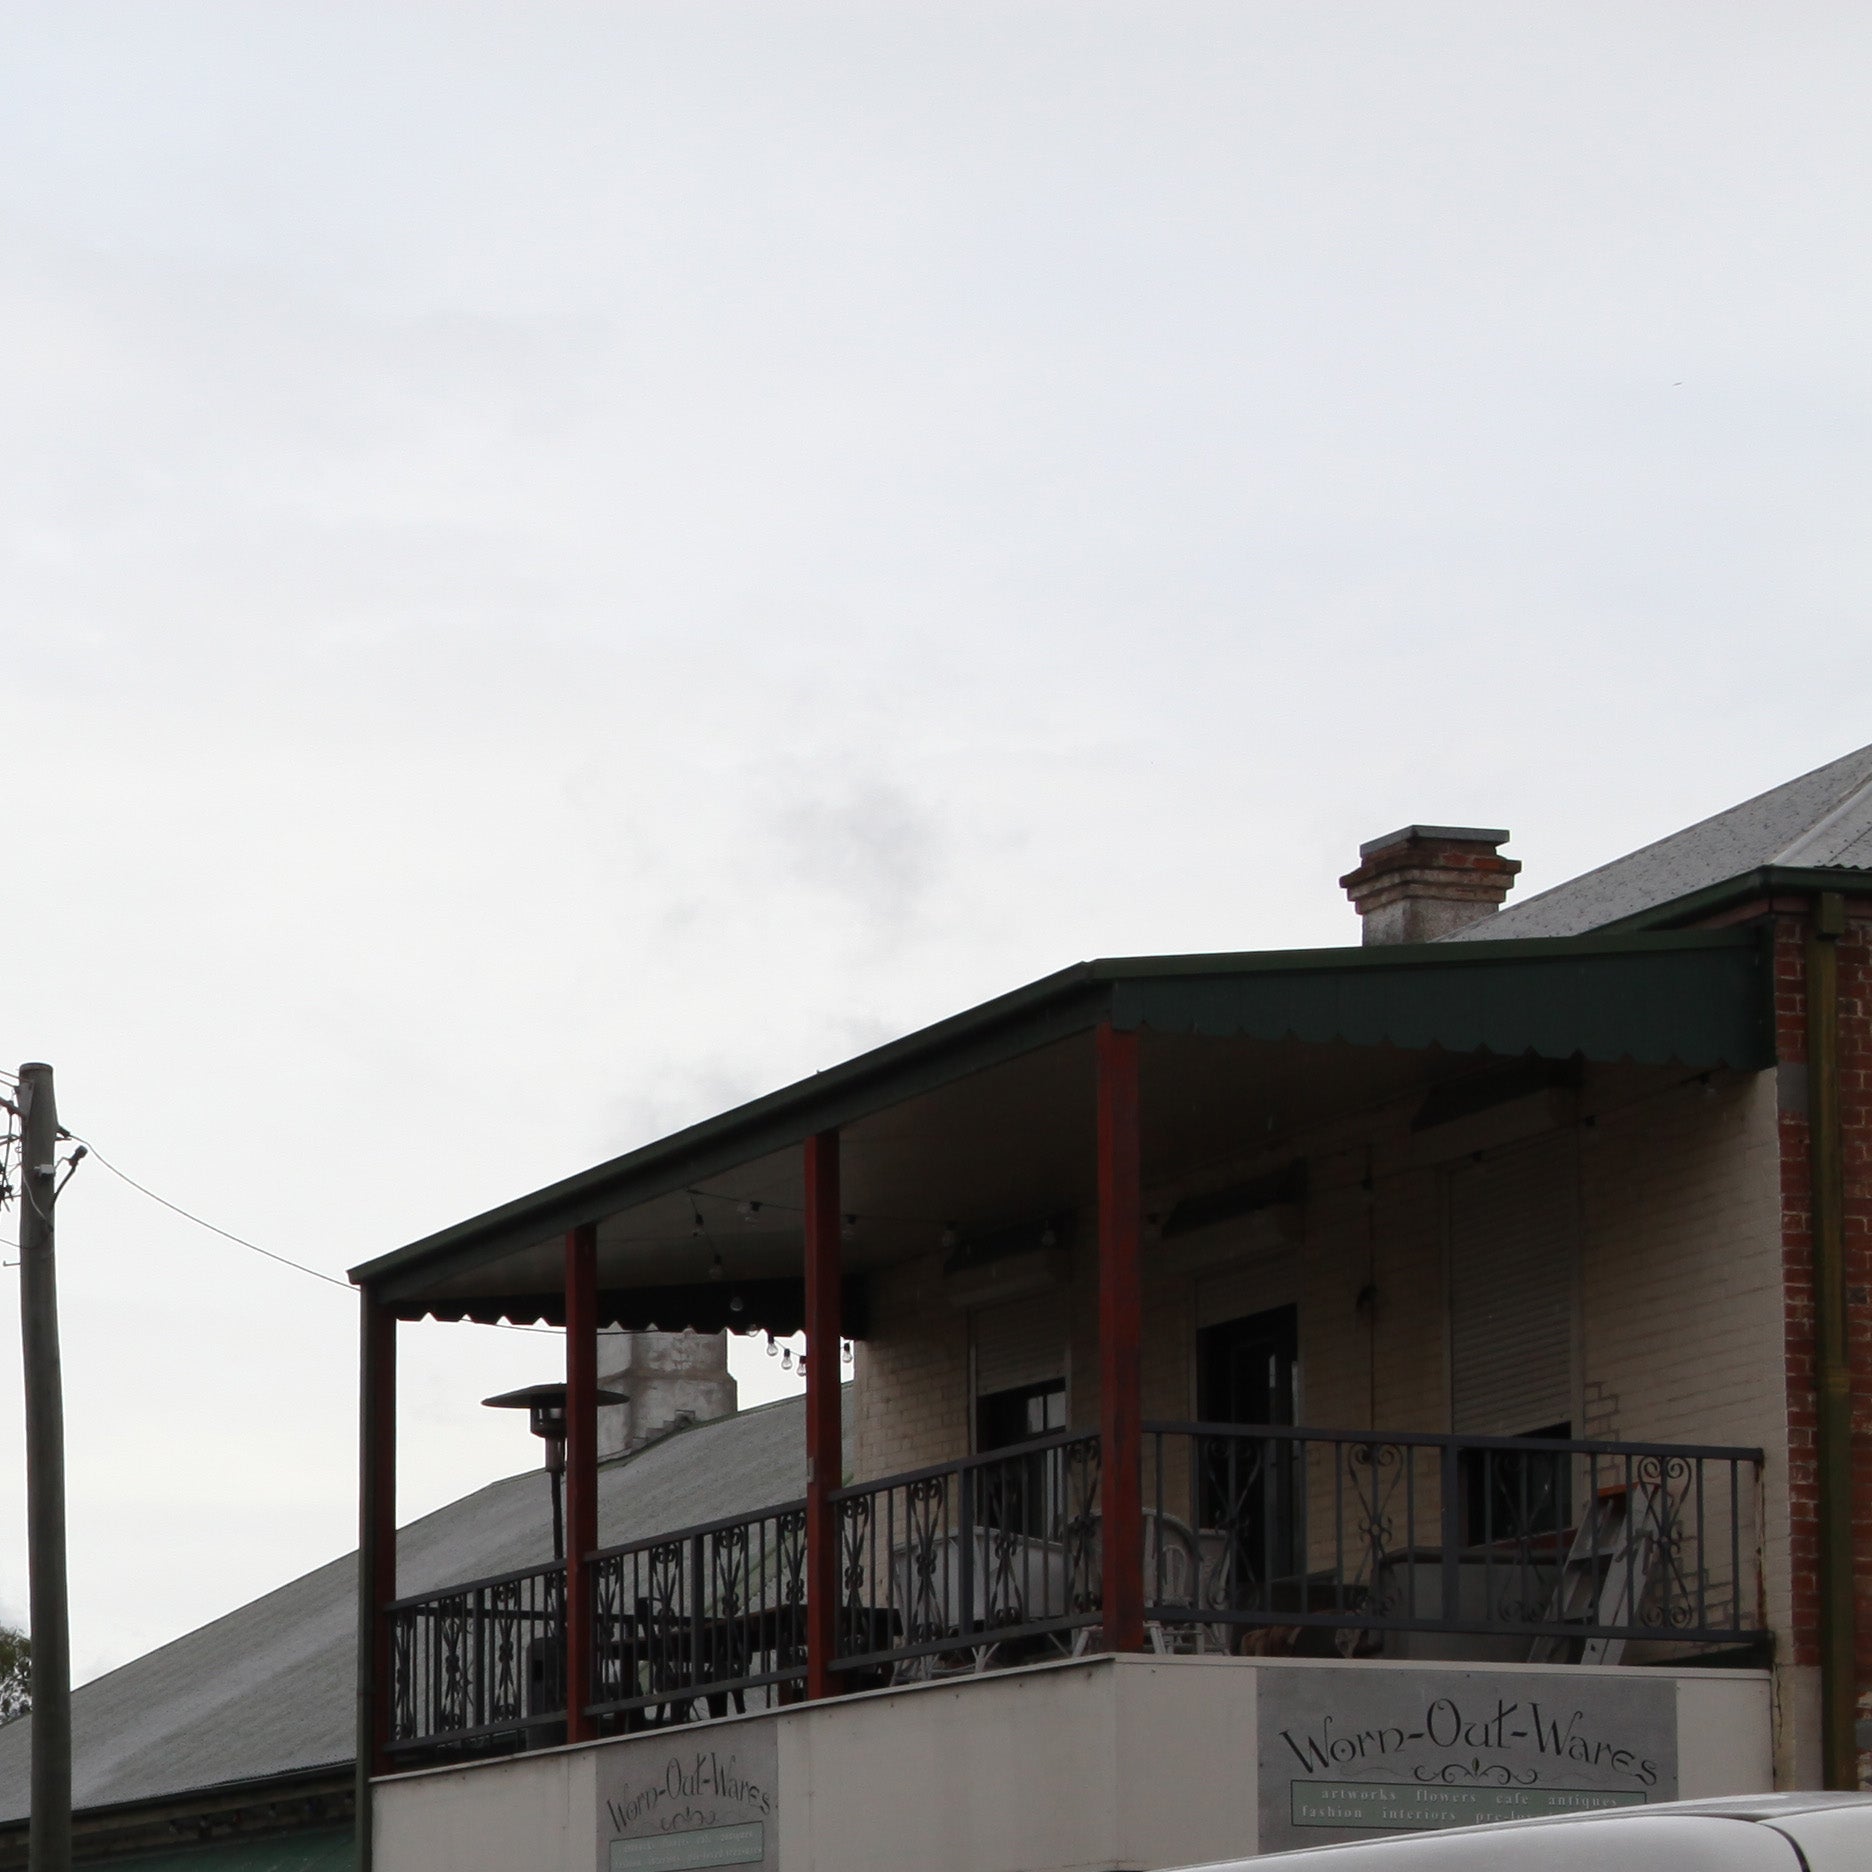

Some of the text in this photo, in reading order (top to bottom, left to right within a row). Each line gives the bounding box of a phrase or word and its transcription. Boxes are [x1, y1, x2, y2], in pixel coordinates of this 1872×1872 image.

[1278, 1697, 1658, 1786] Worn-Out-Wares
[1321, 1788, 1618, 1811] artworks flowers cafe antiques
[1302, 1805, 1363, 1819] fashion
[1382, 1807, 1457, 1821] interiors
